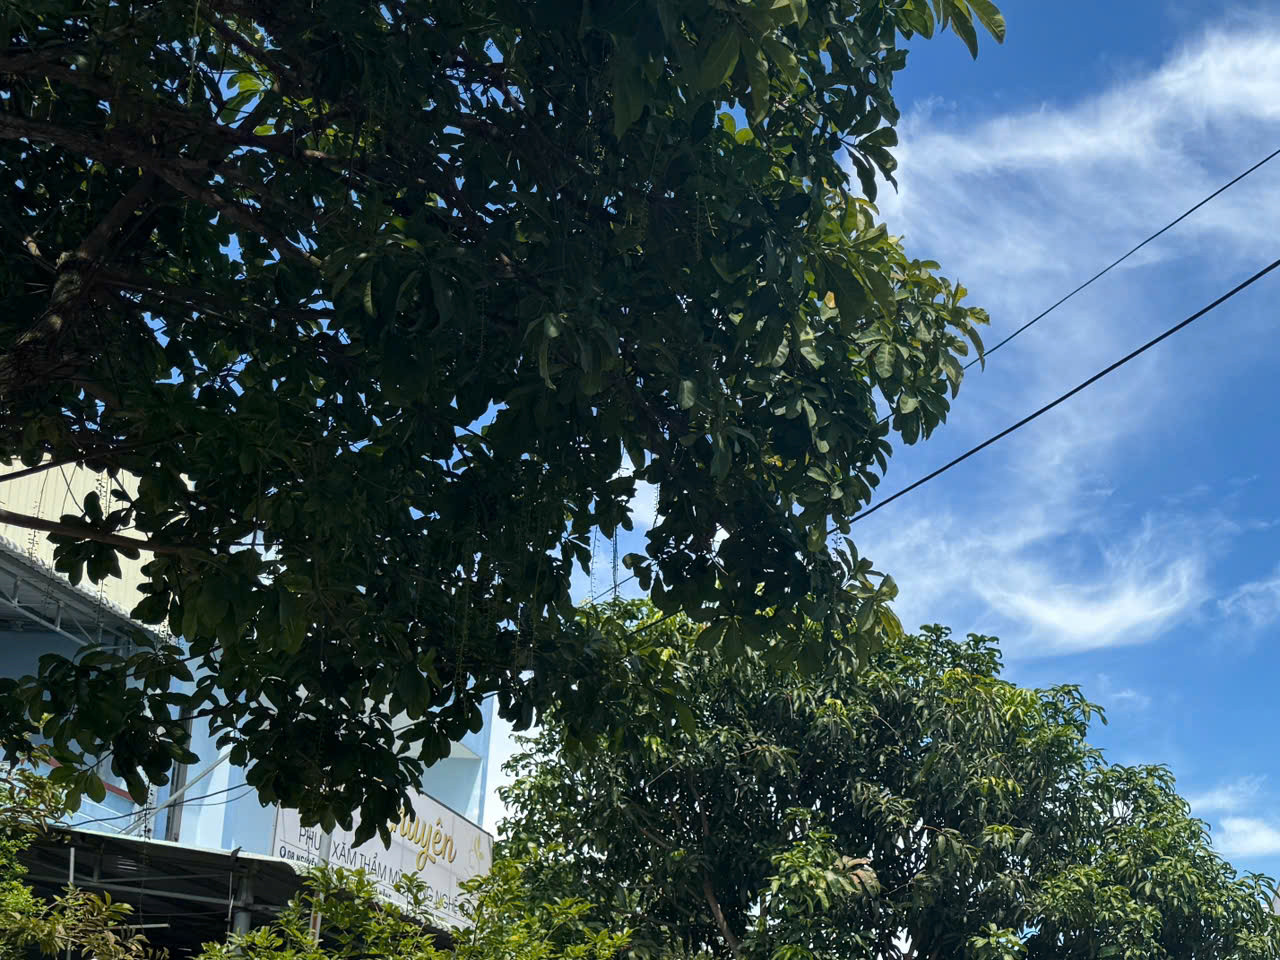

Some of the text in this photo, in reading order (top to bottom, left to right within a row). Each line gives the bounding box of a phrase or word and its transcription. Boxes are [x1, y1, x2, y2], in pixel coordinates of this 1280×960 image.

[299, 827, 321, 851] PHU
[331, 840, 357, 867] XĂM
[388, 807, 457, 871] uyên
